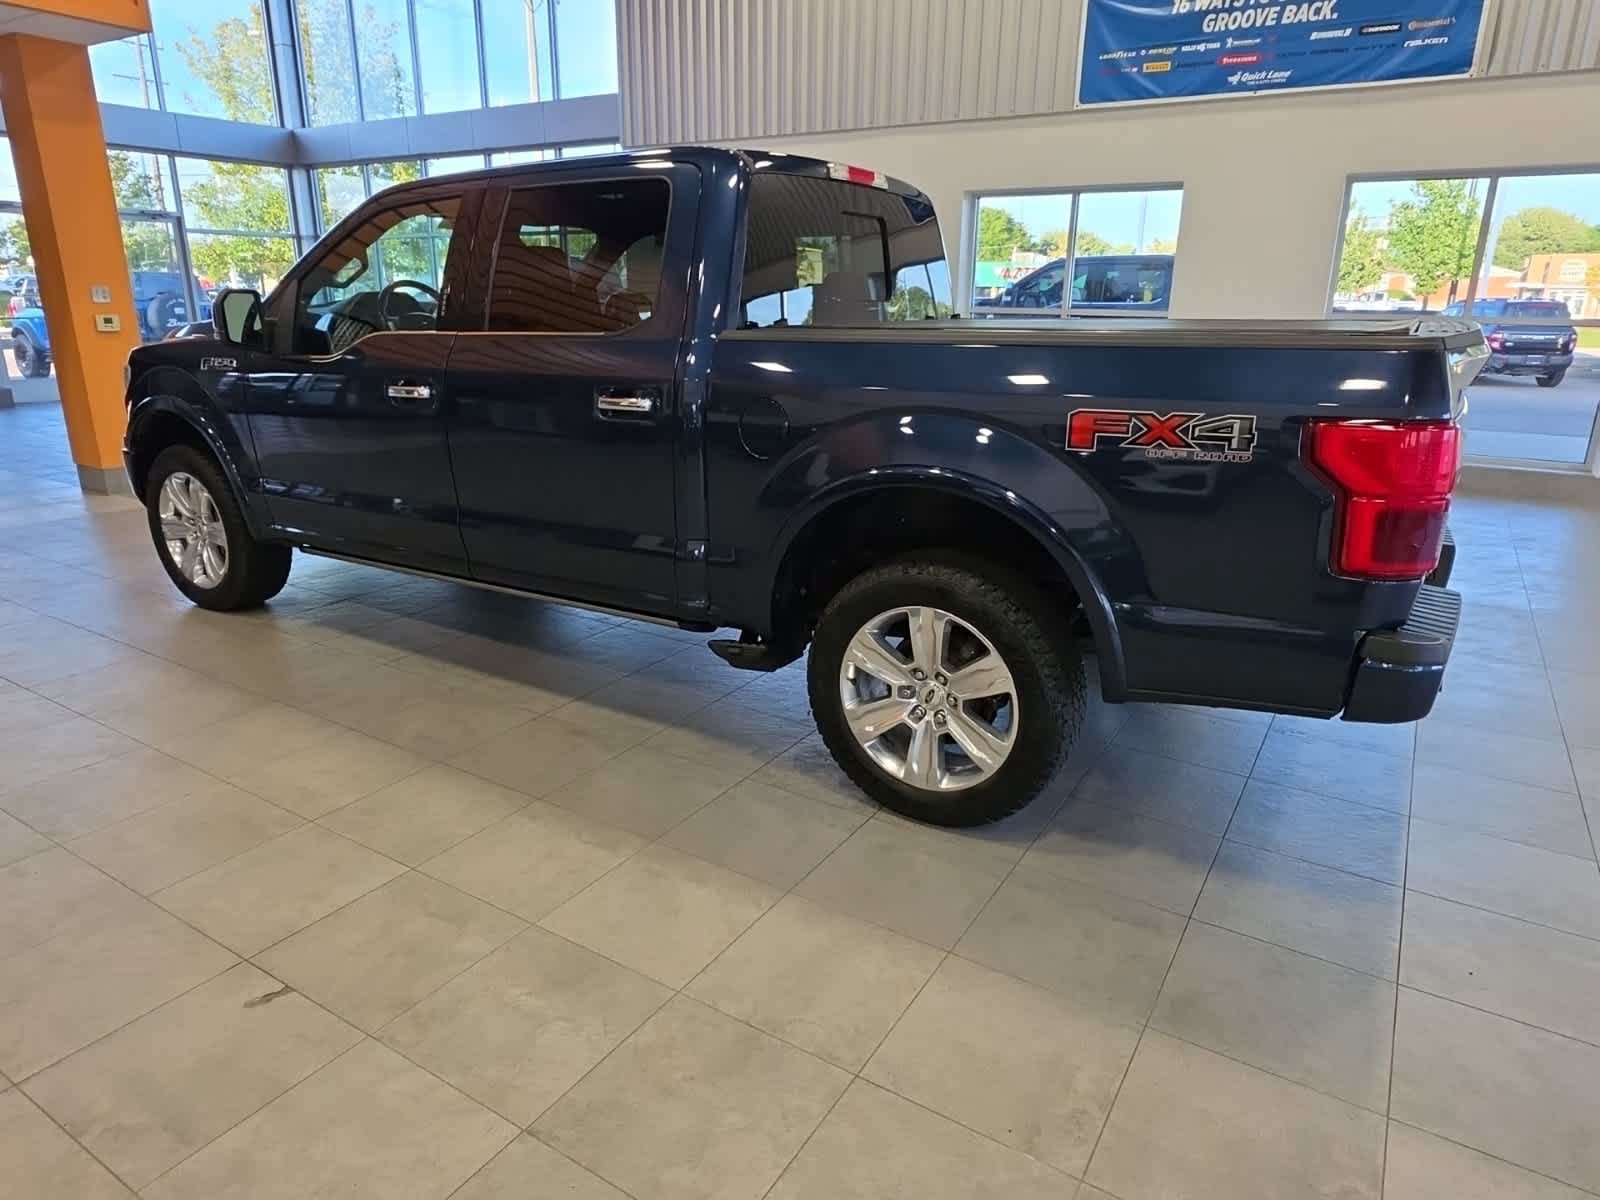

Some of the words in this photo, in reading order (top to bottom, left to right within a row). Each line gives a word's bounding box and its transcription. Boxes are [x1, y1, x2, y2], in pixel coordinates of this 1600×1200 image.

[1202, 7, 1281, 33] GROOVE
[1280, 0, 1339, 24] BACK.
[1240, 71, 1267, 82] Quick
[1065, 408, 1257, 454] FX4
